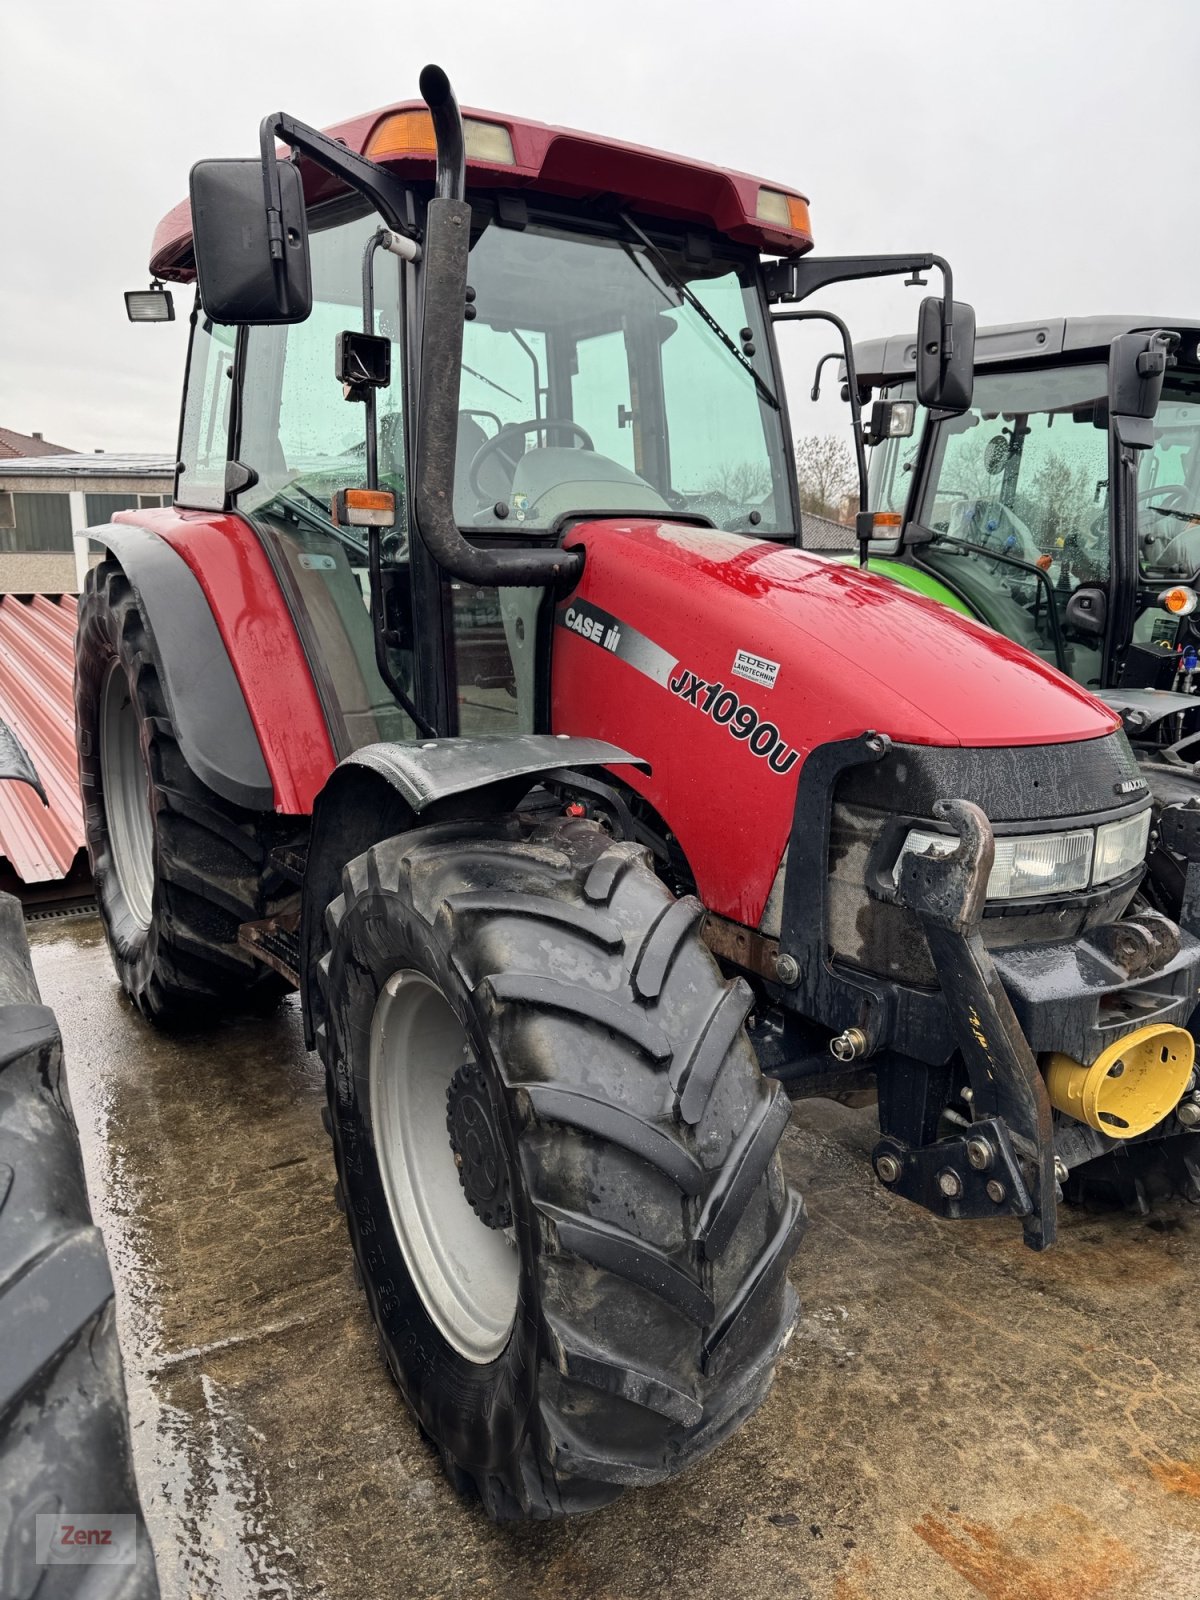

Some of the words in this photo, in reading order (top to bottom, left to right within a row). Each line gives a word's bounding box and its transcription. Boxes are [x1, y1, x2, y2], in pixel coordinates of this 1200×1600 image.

[565, 608, 604, 643] CASE
[734, 662, 775, 682] LANDTECHNIK
[738, 653, 777, 673] EDER
[670, 669, 801, 774] JX1090U
